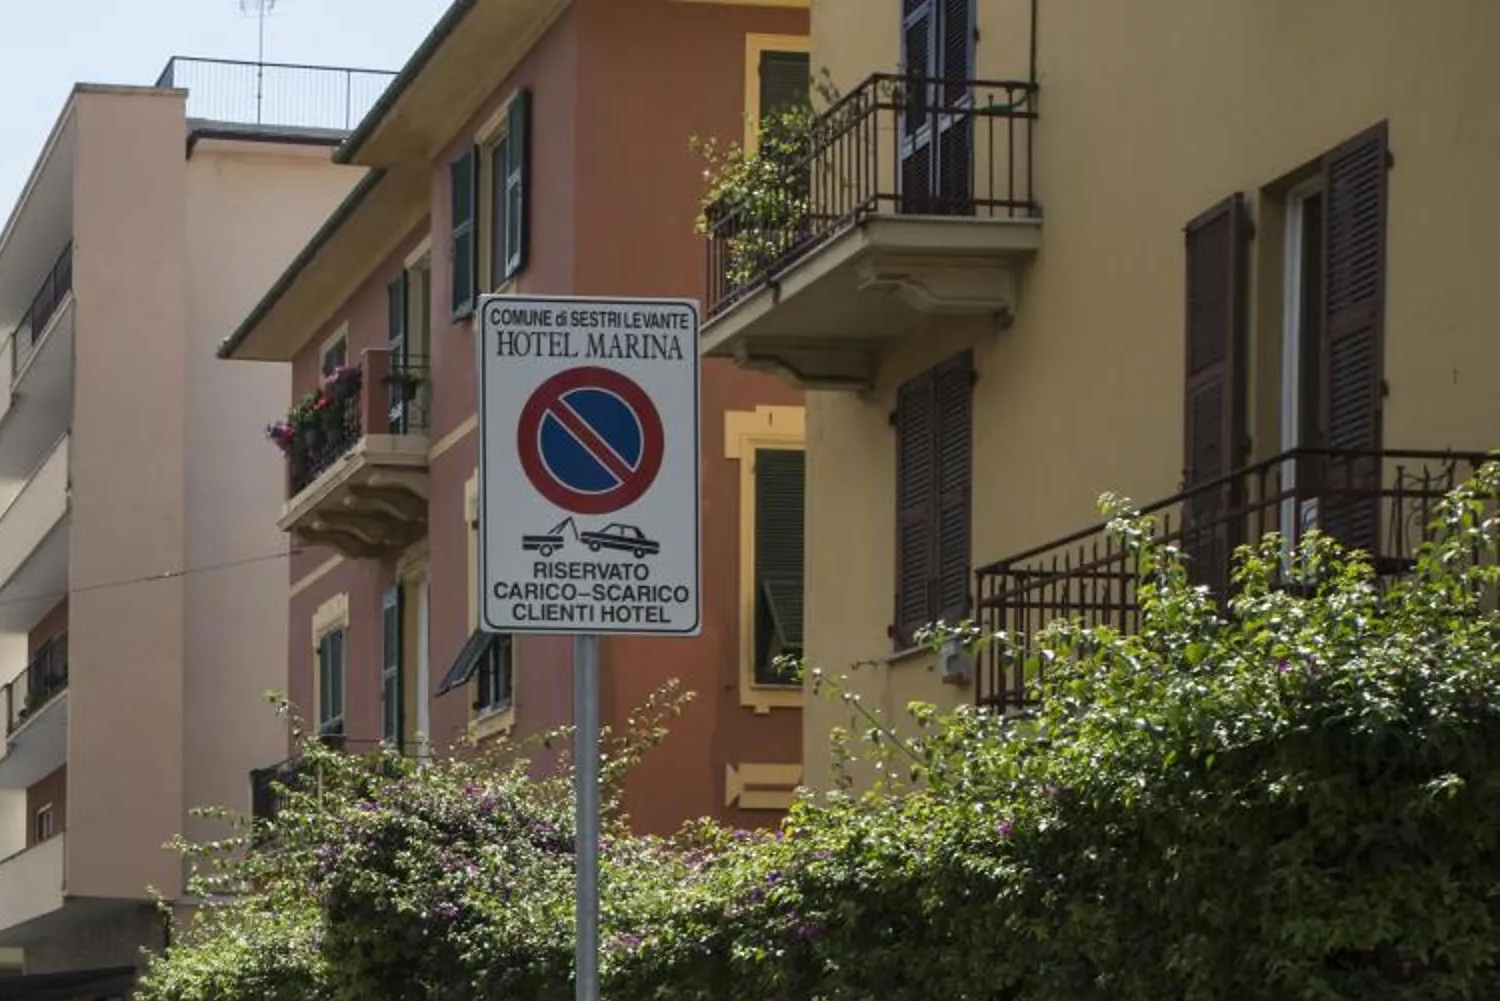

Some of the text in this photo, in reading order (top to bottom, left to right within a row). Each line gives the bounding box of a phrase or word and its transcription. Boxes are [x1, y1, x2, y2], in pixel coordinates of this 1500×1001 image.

[490, 308, 690, 329] COMUNE di SESTRI LEVANTE
[496, 331, 684, 360] HOTEL MARINA
[533, 561, 650, 581] RISERVATO
[512, 603, 672, 624] CLIENTI HOTEL
